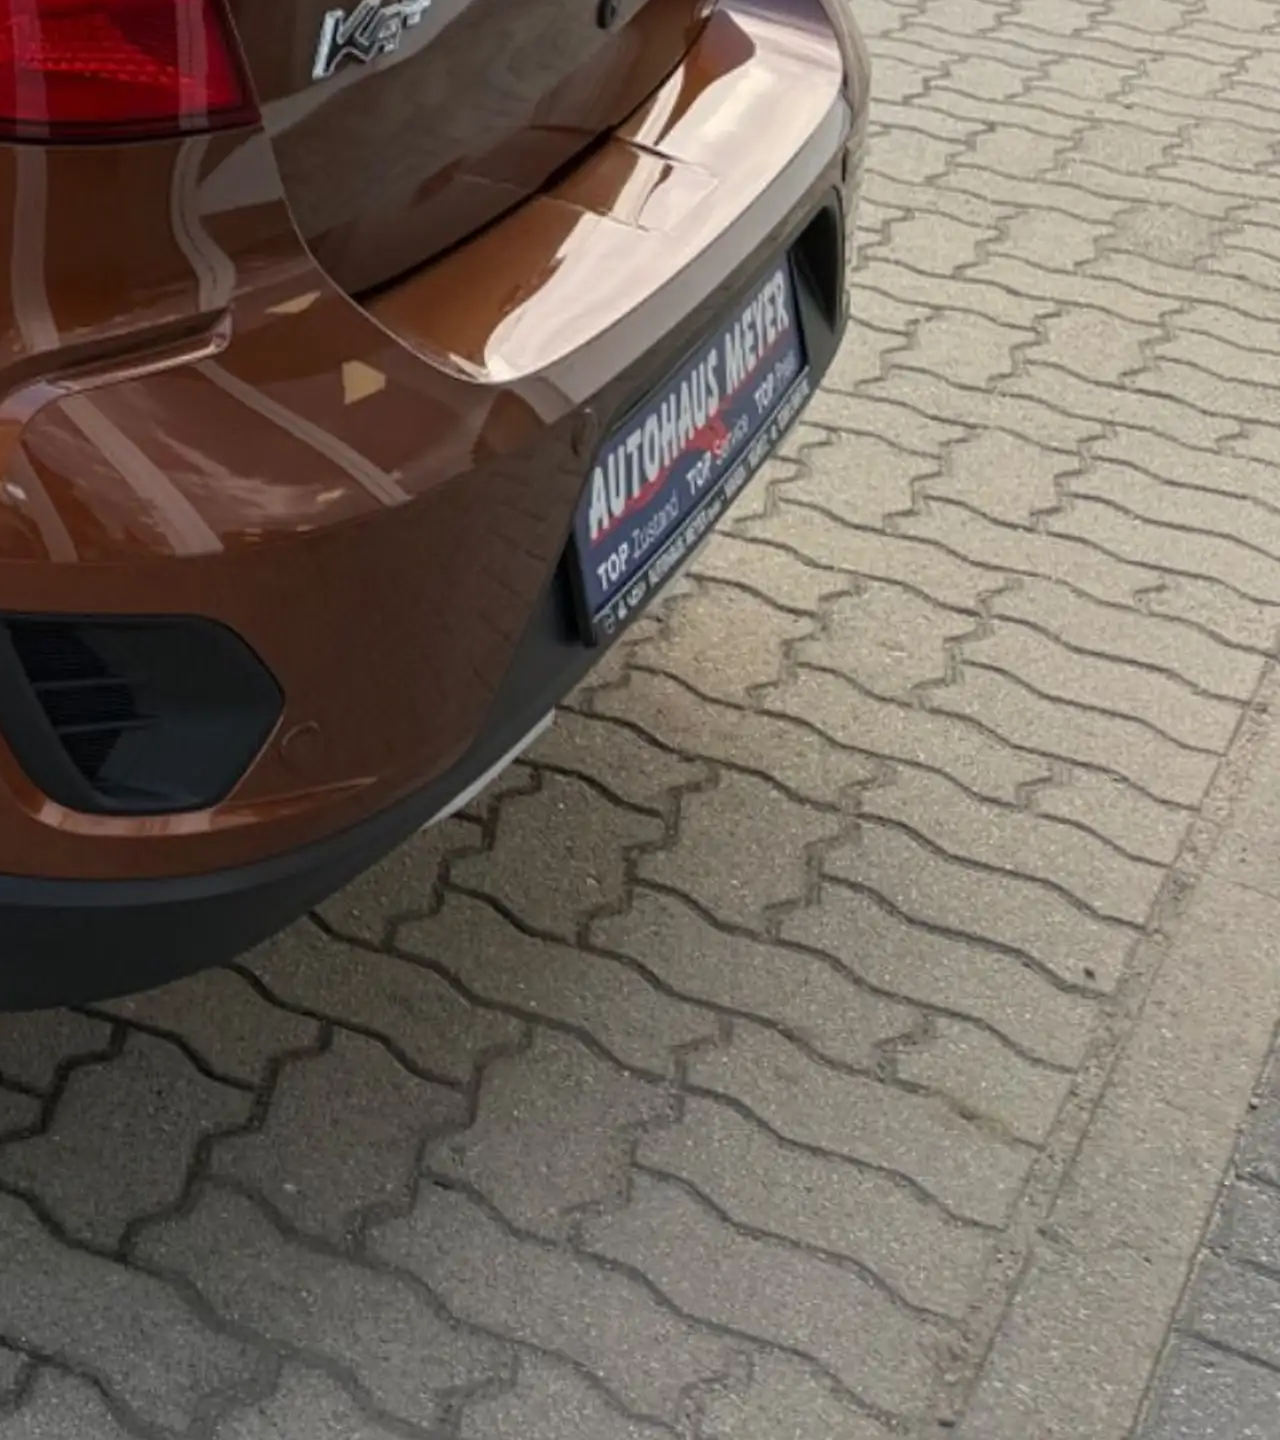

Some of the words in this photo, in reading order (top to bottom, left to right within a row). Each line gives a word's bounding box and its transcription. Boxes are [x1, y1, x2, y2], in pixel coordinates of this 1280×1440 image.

[588, 347, 720, 541] AUTOHAUS
[724, 268, 790, 396] MEYER
[596, 541, 629, 591] TOP
[685, 449, 712, 497] TOP
